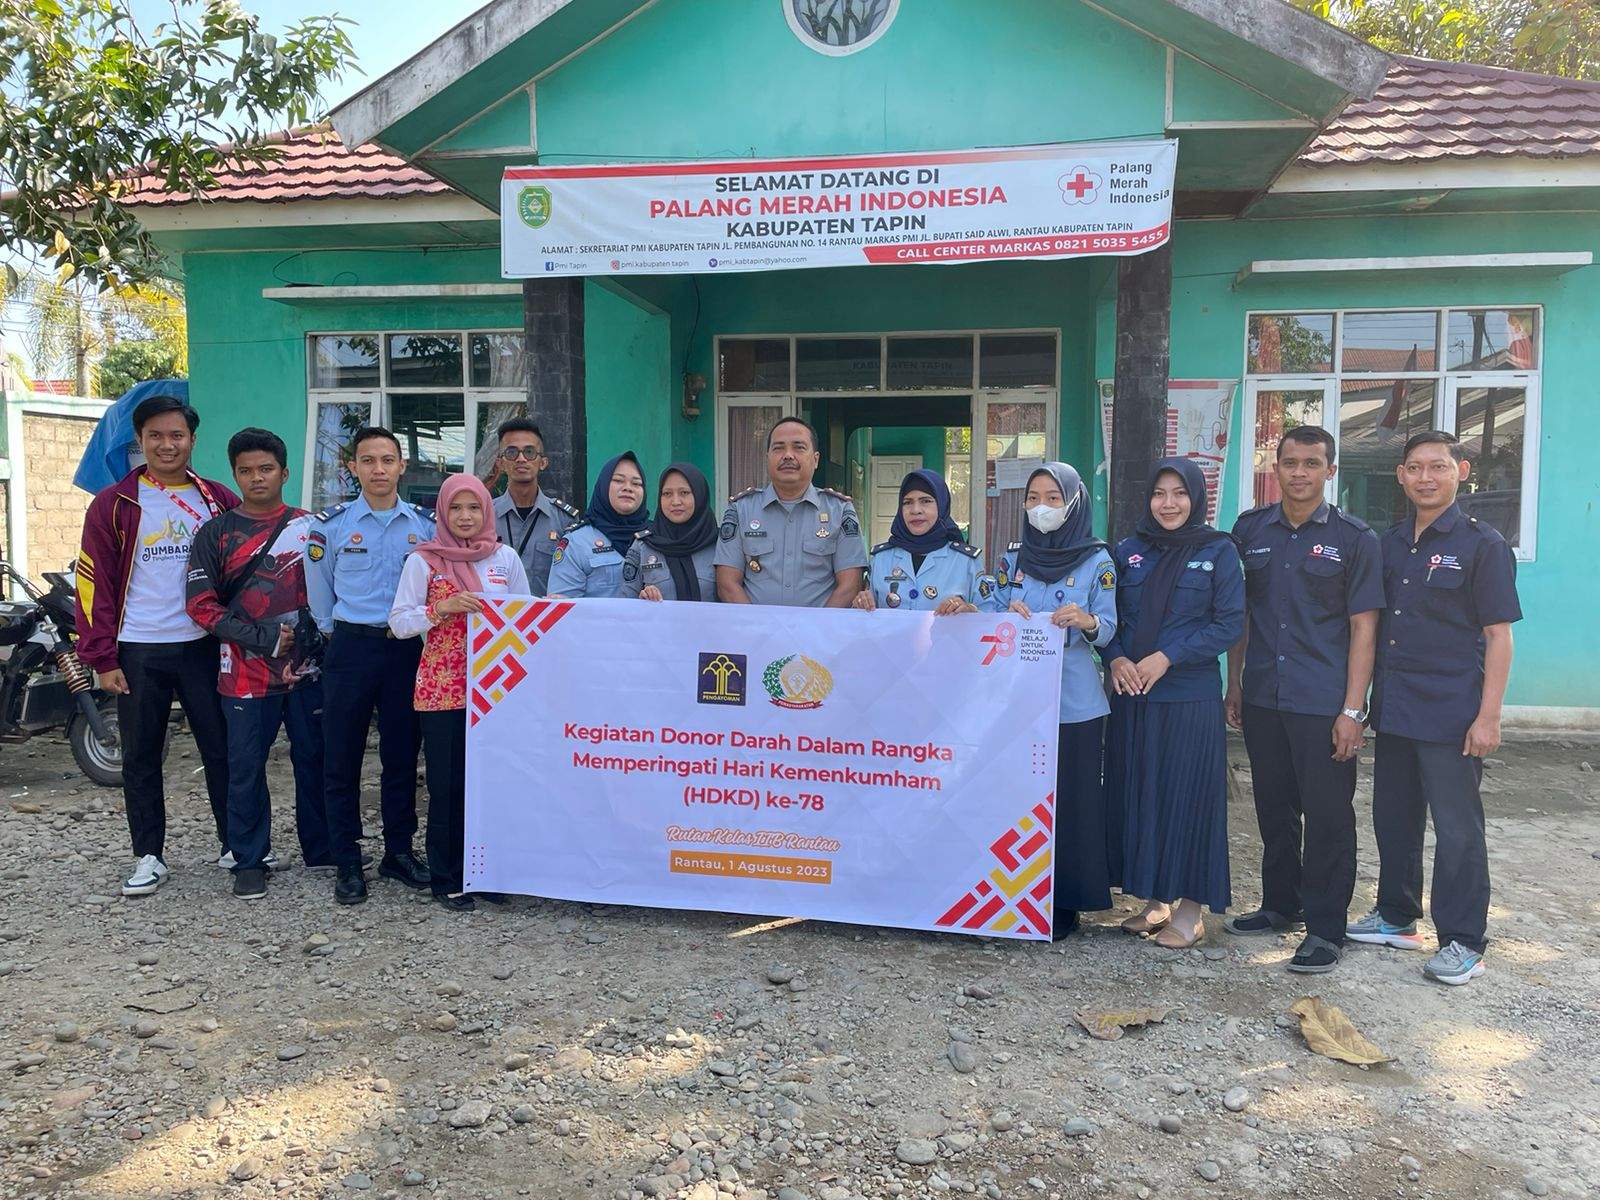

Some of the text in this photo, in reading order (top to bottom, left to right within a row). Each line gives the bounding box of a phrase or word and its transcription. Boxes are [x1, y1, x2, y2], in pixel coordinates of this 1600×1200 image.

[715, 168, 939, 193] SELAMAT DATANG DI
[1110, 163, 1152, 175] Palang
[1110, 177, 1148, 189] Merah
[650, 186, 1007, 218] PALANG MERAH INDONESIA
[1109, 189, 1170, 204] Indonesia
[541, 245, 574, 254] ALAMAT
[579, 244, 629, 254] SEKRETARIAT
[631, 244, 646, 252] PMI
[648, 243, 694, 252] KABUPATEN
[697, 242, 720, 251] TAPIN
[722, 242, 732, 250] JL.
[734, 240, 798, 250] PEMBANGUNAN
[801, 239, 815, 248] NO.
[818, 238, 827, 247] 14
[829, 236, 863, 246] RANTAU
[865, 235, 901, 245] MARKAS
[902, 234, 918, 243] PMI
[919, 233, 930, 242] JL.
[933, 231, 963, 241] BUPATI
[965, 230, 985, 239] SAID
[987, 228, 1011, 238] ALWI,
[1013, 226, 1049, 237] RANTAU
[1051, 224, 1104, 234] KABUPATEN
[1106, 222, 1133, 232] TAPIN
[726, 214, 926, 238] KABUPATEN TAPIN
[897, 229, 1163, 259] CALL CENTER MARKAS 0821 5035 5455
[569, 262, 587, 270] Tapin
[853, 361, 919, 370] KABUATEN
[564, 723, 953, 763] Kegiatan Donor Darah Dalam Rangka
[573, 752, 942, 791] Memperingati Hari Kemenkumham
[683, 786, 825, 811] (HDKD) ke-78
[667, 826, 841, 852] Rutan Kelas IIB Rantau
[674, 857, 828, 877] Rantau, 1 Agustus 2023
